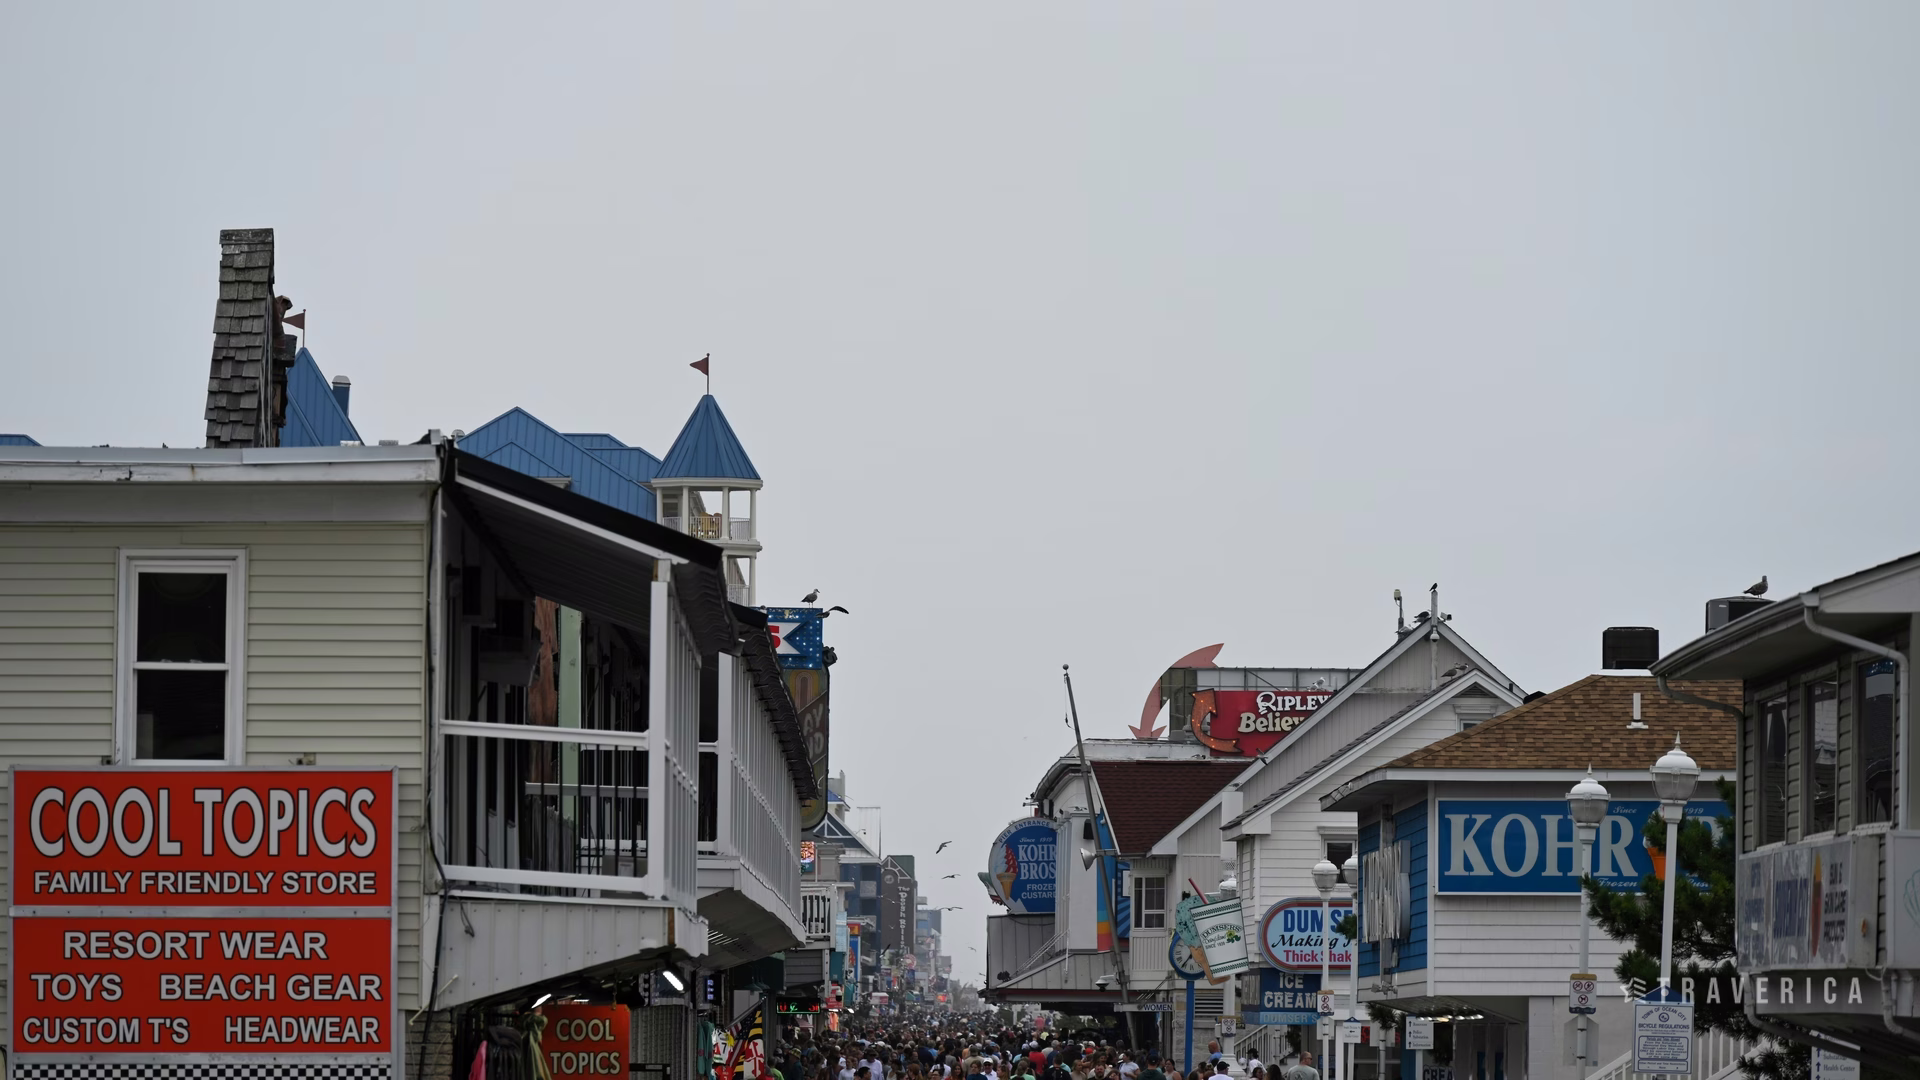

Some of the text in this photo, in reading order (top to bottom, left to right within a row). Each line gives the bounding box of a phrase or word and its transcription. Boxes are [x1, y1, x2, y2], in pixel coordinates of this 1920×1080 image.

[1612, 805, 1638, 814] Since
[30, 787, 378, 858] COOL TOPICS
[999, 820, 1050, 843] PIER ENTRANCE
[34, 871, 376, 894] FAMILY FRIENDLY STORE
[1596, 877, 1638, 887] Frozen
[63, 931, 329, 960] RESORT WEAR
[1283, 950, 1319, 963] Thick
[30, 973, 383, 1002] TOYS BEACH GEAR
[1279, 972, 1304, 989] ICE
[1143, 1003, 1173, 1011] WOMEN
[1263, 991, 1317, 1009] CREAM
[1263, 1013, 1319, 1023] DUMSER'S
[1641, 1009, 1654, 1020] TOWN
[1661, 1006, 1678, 1014] OCEAN
[1677, 1011, 1687, 1021] CITY
[22, 1016, 380, 1044] CUSTOM T'S HEADWEAR
[556, 1018, 615, 1042] COOL
[550, 1051, 621, 1075] TOPICS
[1839, 1064, 1856, 1072] Center
